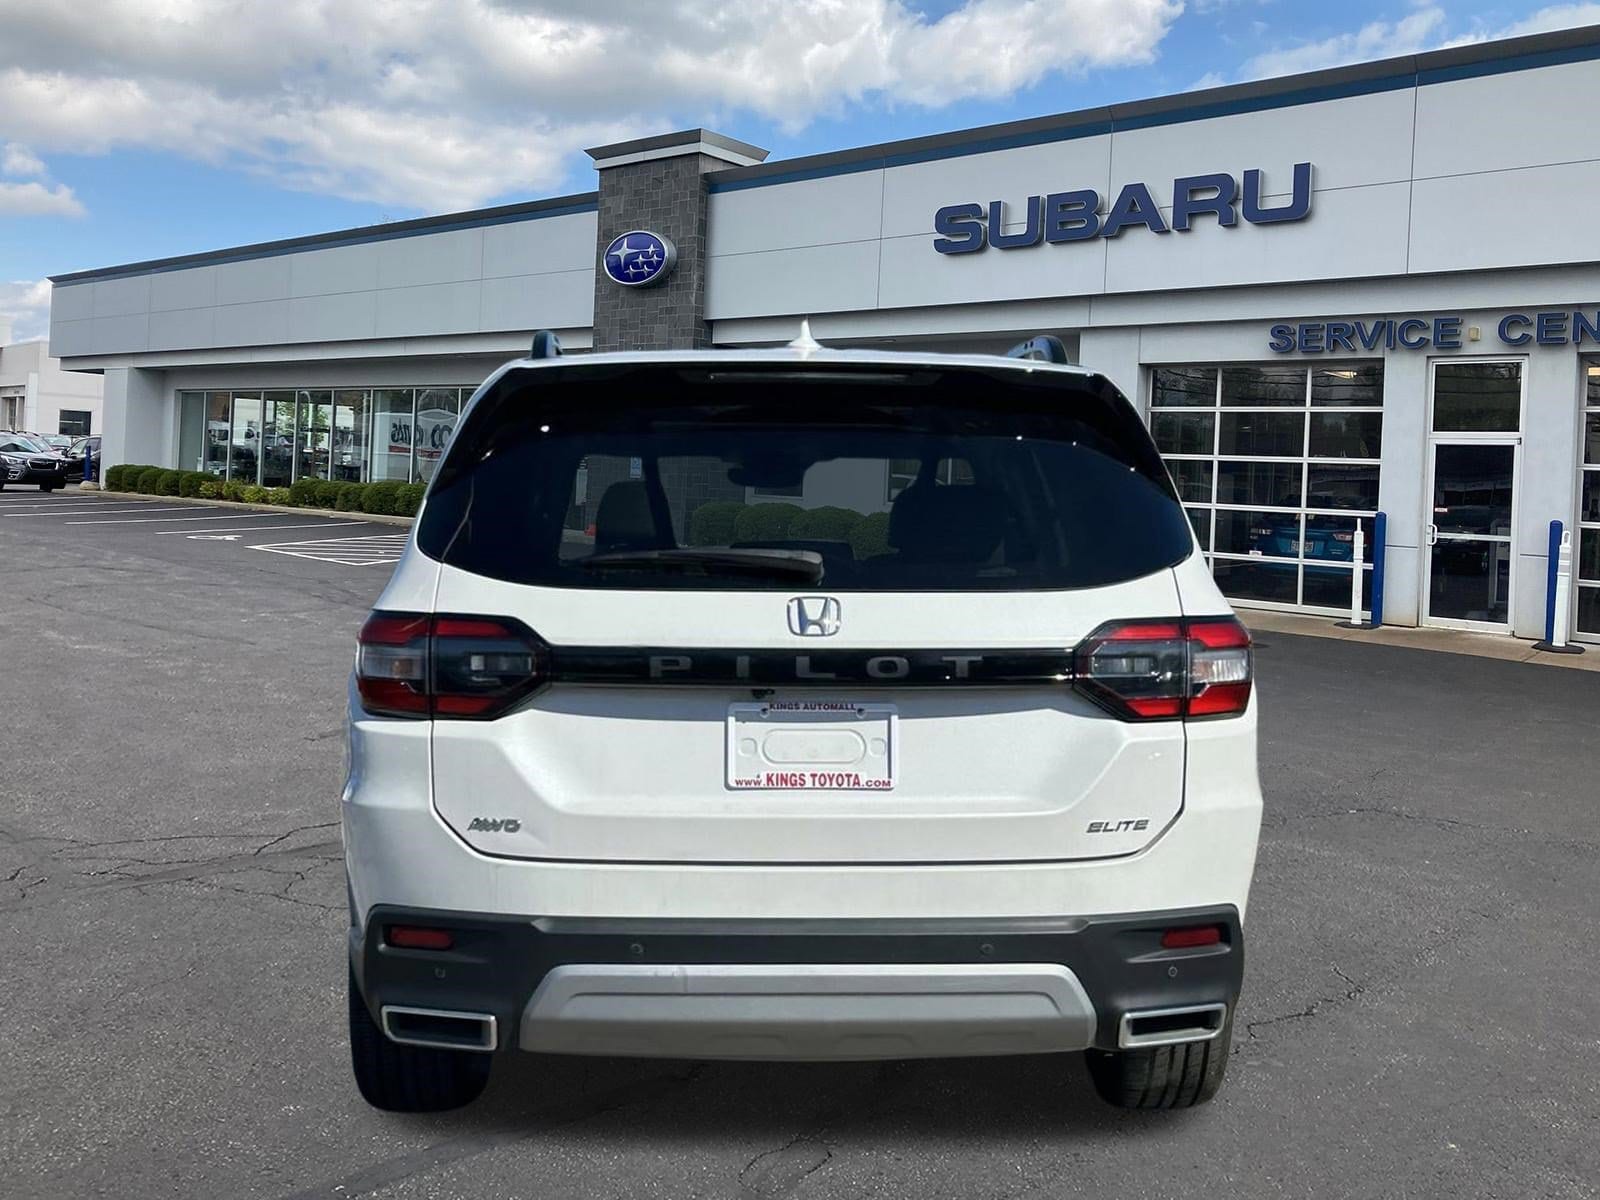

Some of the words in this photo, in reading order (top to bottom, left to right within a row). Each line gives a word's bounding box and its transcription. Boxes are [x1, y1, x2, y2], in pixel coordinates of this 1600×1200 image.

[933, 162, 1314, 256] SUBARU
[1269, 318, 1463, 352] SERVICE
[649, 655, 983, 678] PILOT
[769, 703, 800, 711] KINGS
[803, 702, 857, 711] AUTOMALL
[467, 817, 522, 833] AWD
[1086, 819, 1149, 833] ELITE
